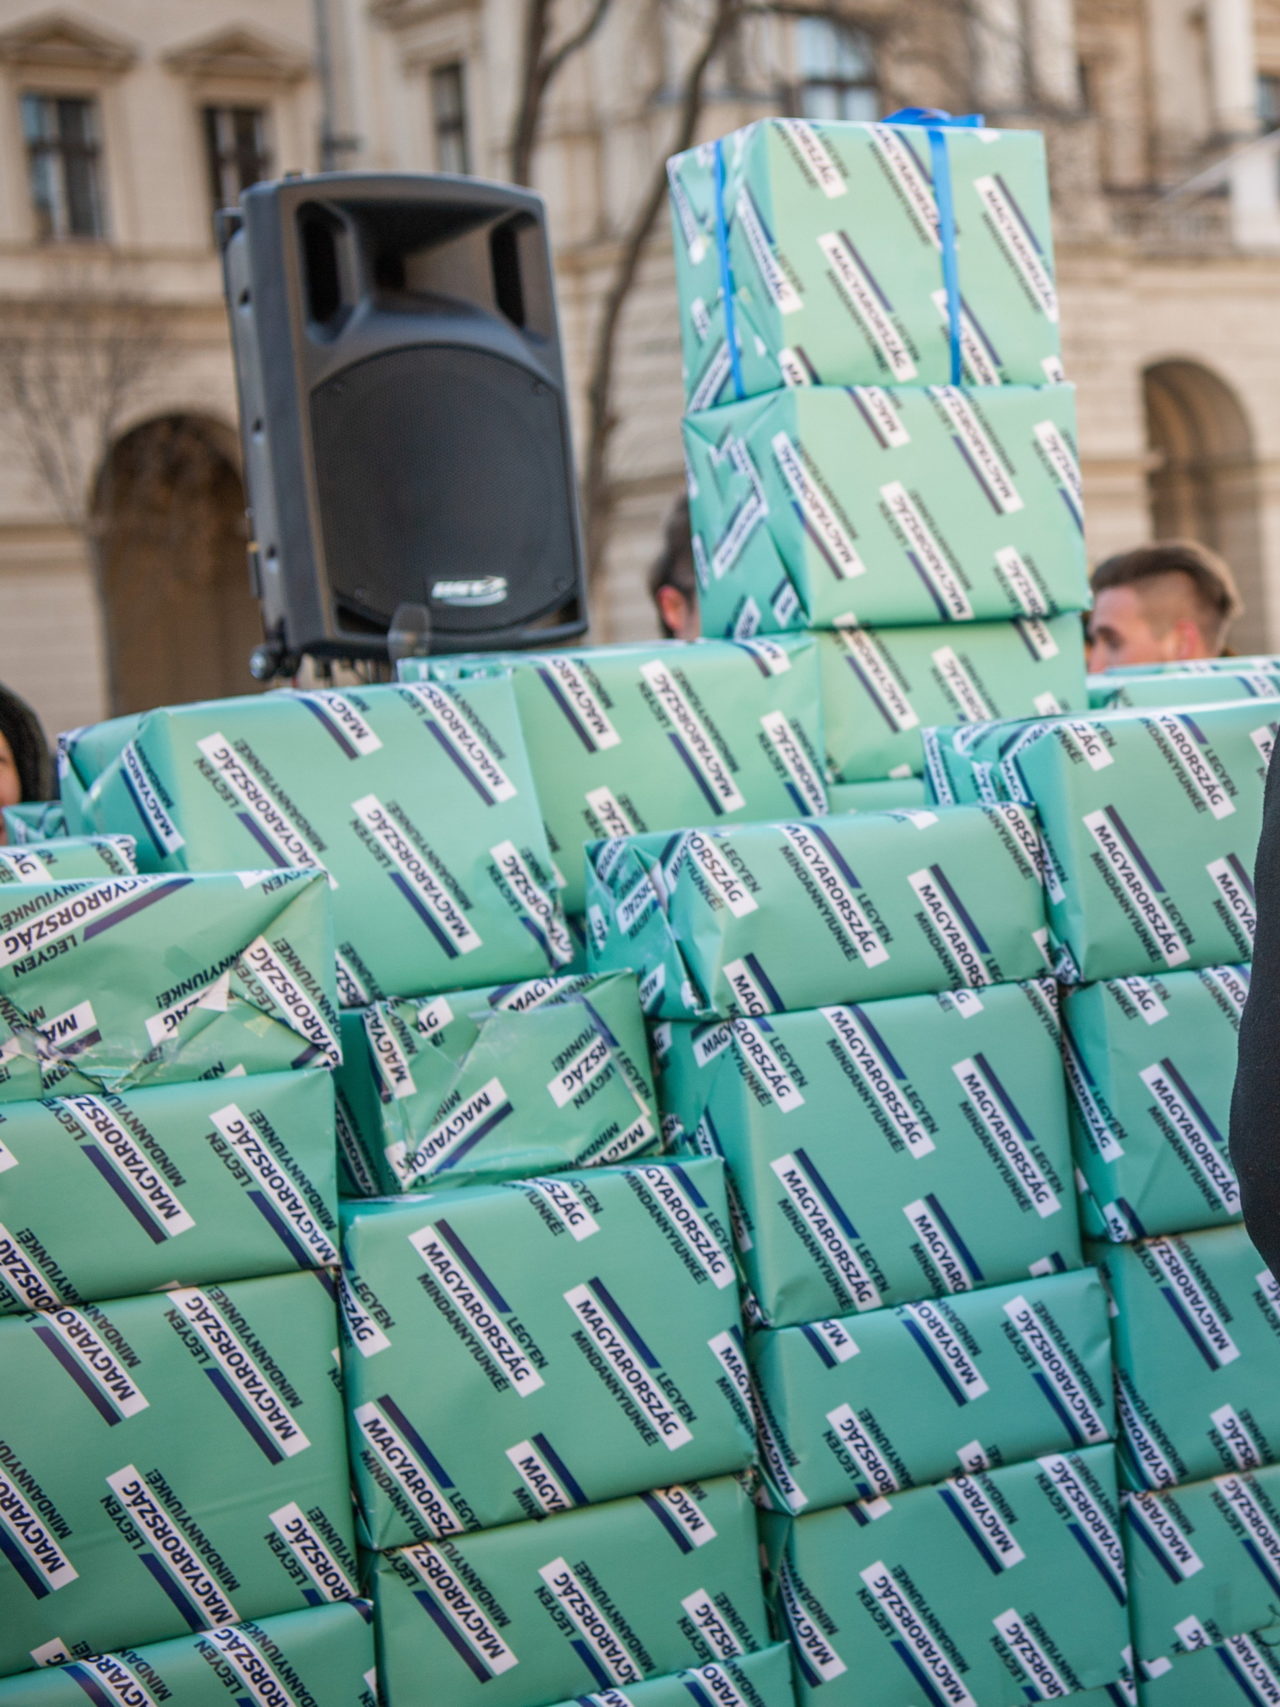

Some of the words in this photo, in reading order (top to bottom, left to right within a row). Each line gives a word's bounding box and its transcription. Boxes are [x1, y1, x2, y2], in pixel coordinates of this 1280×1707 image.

[193, 758, 240, 810] LEGYEN
[655, 673, 734, 799] MAGYARORSZÁG
[1204, 748, 1239, 798] LEGYEN
[233, 738, 328, 853] MINDANNYIUNKÉ!
[349, 819, 392, 869] LEGYEN
[366, 808, 469, 939] MAGYARORSZÁG
[387, 800, 473, 912] MINDANNYIUNKÉ!
[719, 842, 758, 893] LEGYEN
[779, 845, 858, 961] MINDANNYIUNKÉ!
[1090, 852, 1162, 962] MINDANNYIUNKÉ!
[1094, 825, 1179, 954] MAGYARORSZÁG
[12, 934, 78, 978] LEGYEN
[858, 894, 892, 944] LEGYEN
[1162, 895, 1195, 946] LEGYEN
[572, 1064, 616, 1109] LEGYEN
[770, 1037, 808, 1087] LEGYEN
[827, 1040, 904, 1153] MINDANNYIUNKÉ!
[831, 1012, 922, 1143] MAGYARORSZÁG
[901, 1086, 939, 1134] LEGYEN
[205, 1132, 253, 1187] LEGYEN
[227, 1120, 335, 1265] MAGYARORSZÁG
[248, 1109, 337, 1231] MINDANNYIUNKÉ!
[960, 1102, 1032, 1213] MINDANNYIUNKÉ!
[964, 1074, 1050, 1204] MAGYARORSZÁG
[1032, 1145, 1064, 1194] LEGYEN
[1148, 1106, 1221, 1211] MINDANNYIUNKÉ!
[1152, 1079, 1239, 1203] MAGYARORSZÁG
[782, 1170, 872, 1302] MAGYARORSZÁG
[854, 1243, 890, 1292] LEGYEN
[164, 1309, 209, 1363] LEGYEN
[208, 1285, 303, 1408] MINDANNYIUNKÉ!
[350, 1276, 395, 1329] LEGYEN
[418, 1273, 509, 1392] MINDANNYIUNKÉ!
[422, 1242, 530, 1381] MAGYARORSZÁG
[506, 1317, 549, 1369] LEGYEN
[1001, 1321, 1036, 1369] LEGYEN
[1032, 1301, 1104, 1407] MINDANNYIUNKÉ!
[186, 1296, 297, 1440] MAGYARORSZÁG
[571, 1331, 658, 1446] MINDANNYIUNKÉ!
[576, 1299, 679, 1435] MAGYARORSZÁG
[655, 1373, 697, 1424] LEGYEN
[1015, 1309, 1100, 1437] MAGYARORSZÁG
[822, 1431, 860, 1480] LEGYEN
[101, 1494, 147, 1550] LEGYEN
[122, 1480, 233, 1624] MAGYARORSZÁG
[145, 1469, 240, 1592] MINDANNYIUNKÉ!
[264, 1532, 308, 1586] LEGYEN
[535, 1587, 576, 1637] LEGYEN
[573, 1561, 655, 1672] MINDANNYIUNKÉ!
[856, 1588, 895, 1637] LEGYEN
[874, 1576, 965, 1704] MAGYARORSZÁG
[891, 1565, 970, 1673] MINDANNYIUNKÉ!
[193, 1640, 242, 1695] LEGYEN
